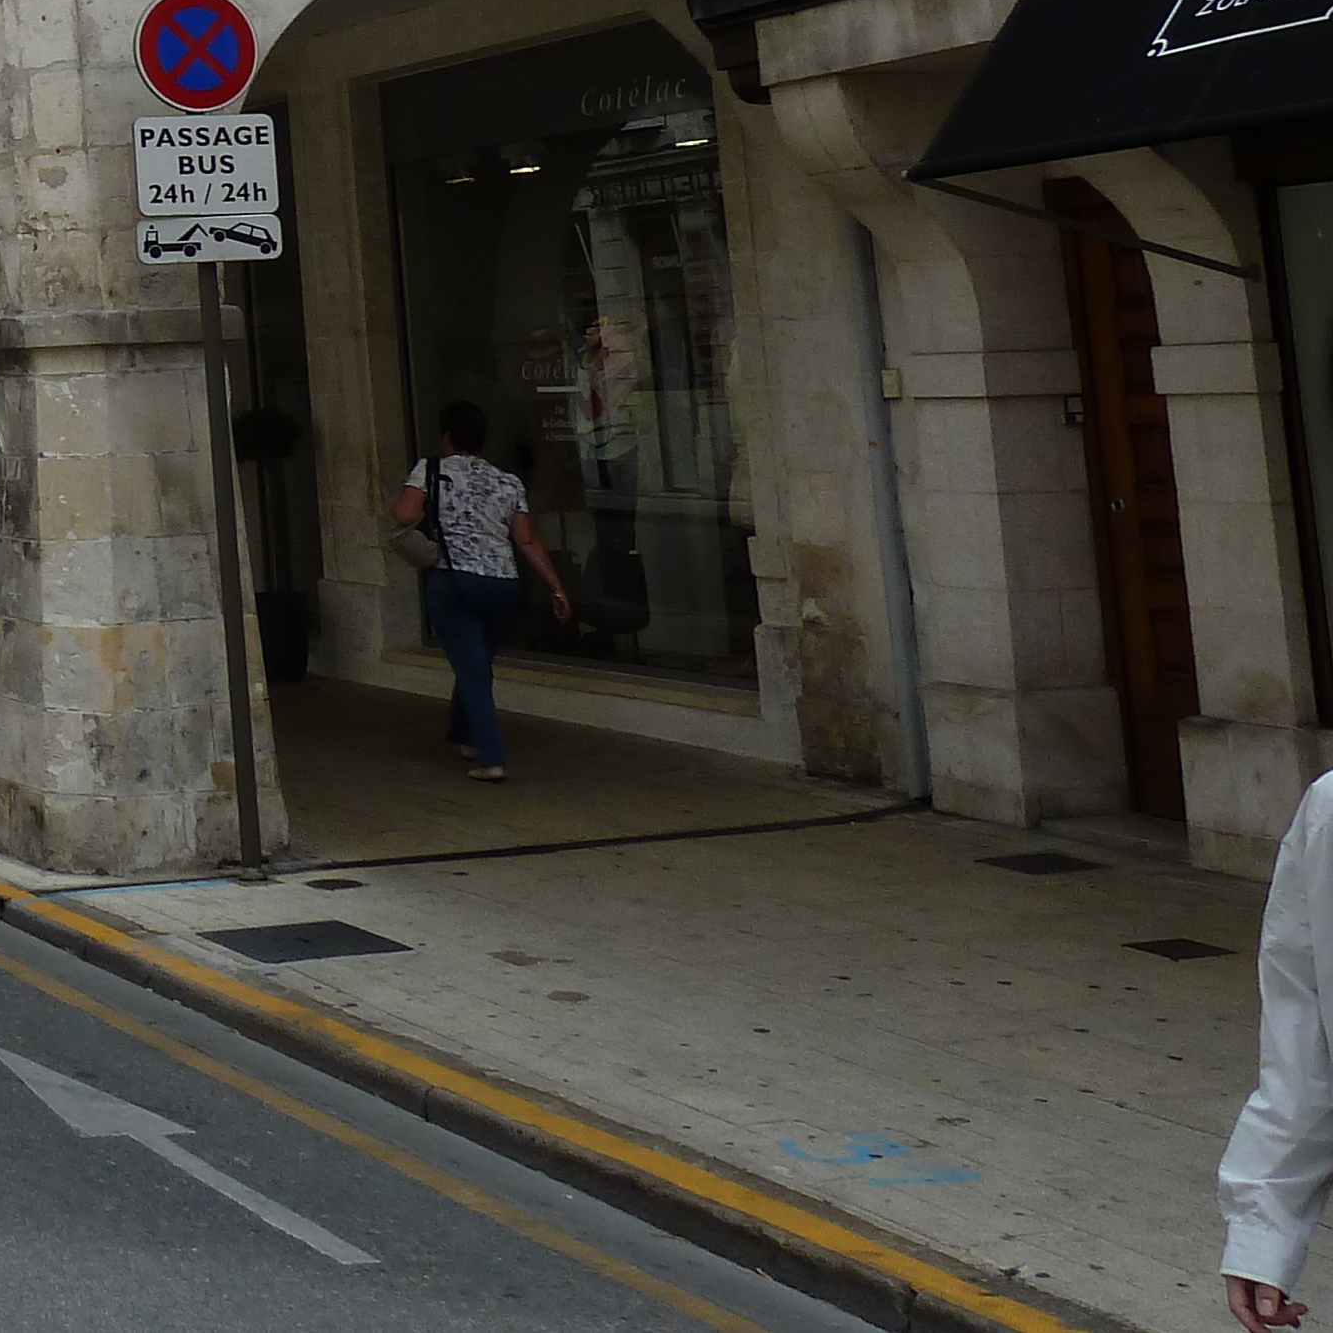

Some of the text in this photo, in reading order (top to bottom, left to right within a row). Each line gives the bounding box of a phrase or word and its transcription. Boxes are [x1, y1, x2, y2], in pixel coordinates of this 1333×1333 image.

[580, 75, 688, 117] Cotélac
[139, 125, 271, 148] PASSAGE
[178, 154, 235, 175] BUS
[148, 182, 268, 205] 24h / 24h
